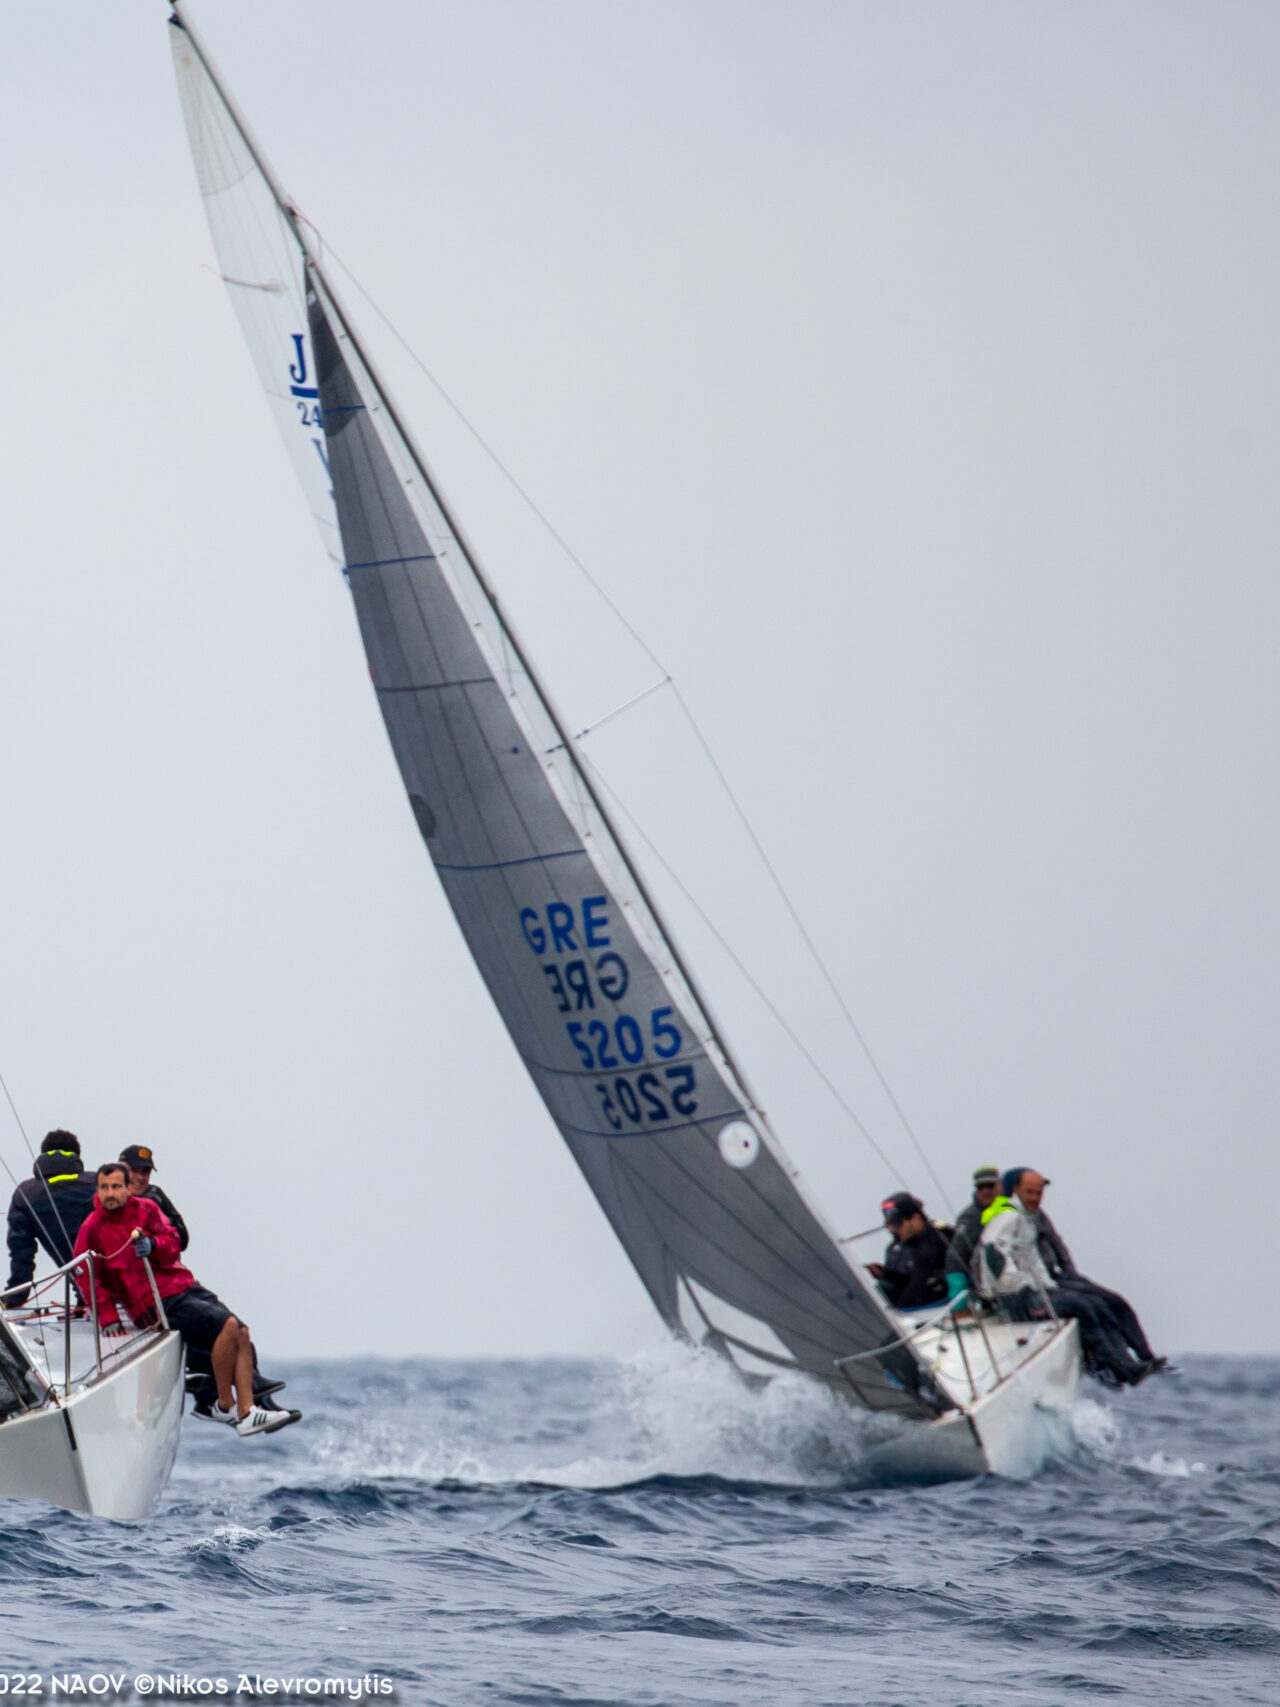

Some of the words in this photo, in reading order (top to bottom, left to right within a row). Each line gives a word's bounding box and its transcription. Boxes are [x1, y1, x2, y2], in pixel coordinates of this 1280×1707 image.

[290, 334, 306, 383] J
[520, 895, 611, 954] GRE
[566, 1005, 682, 1070] 5205
